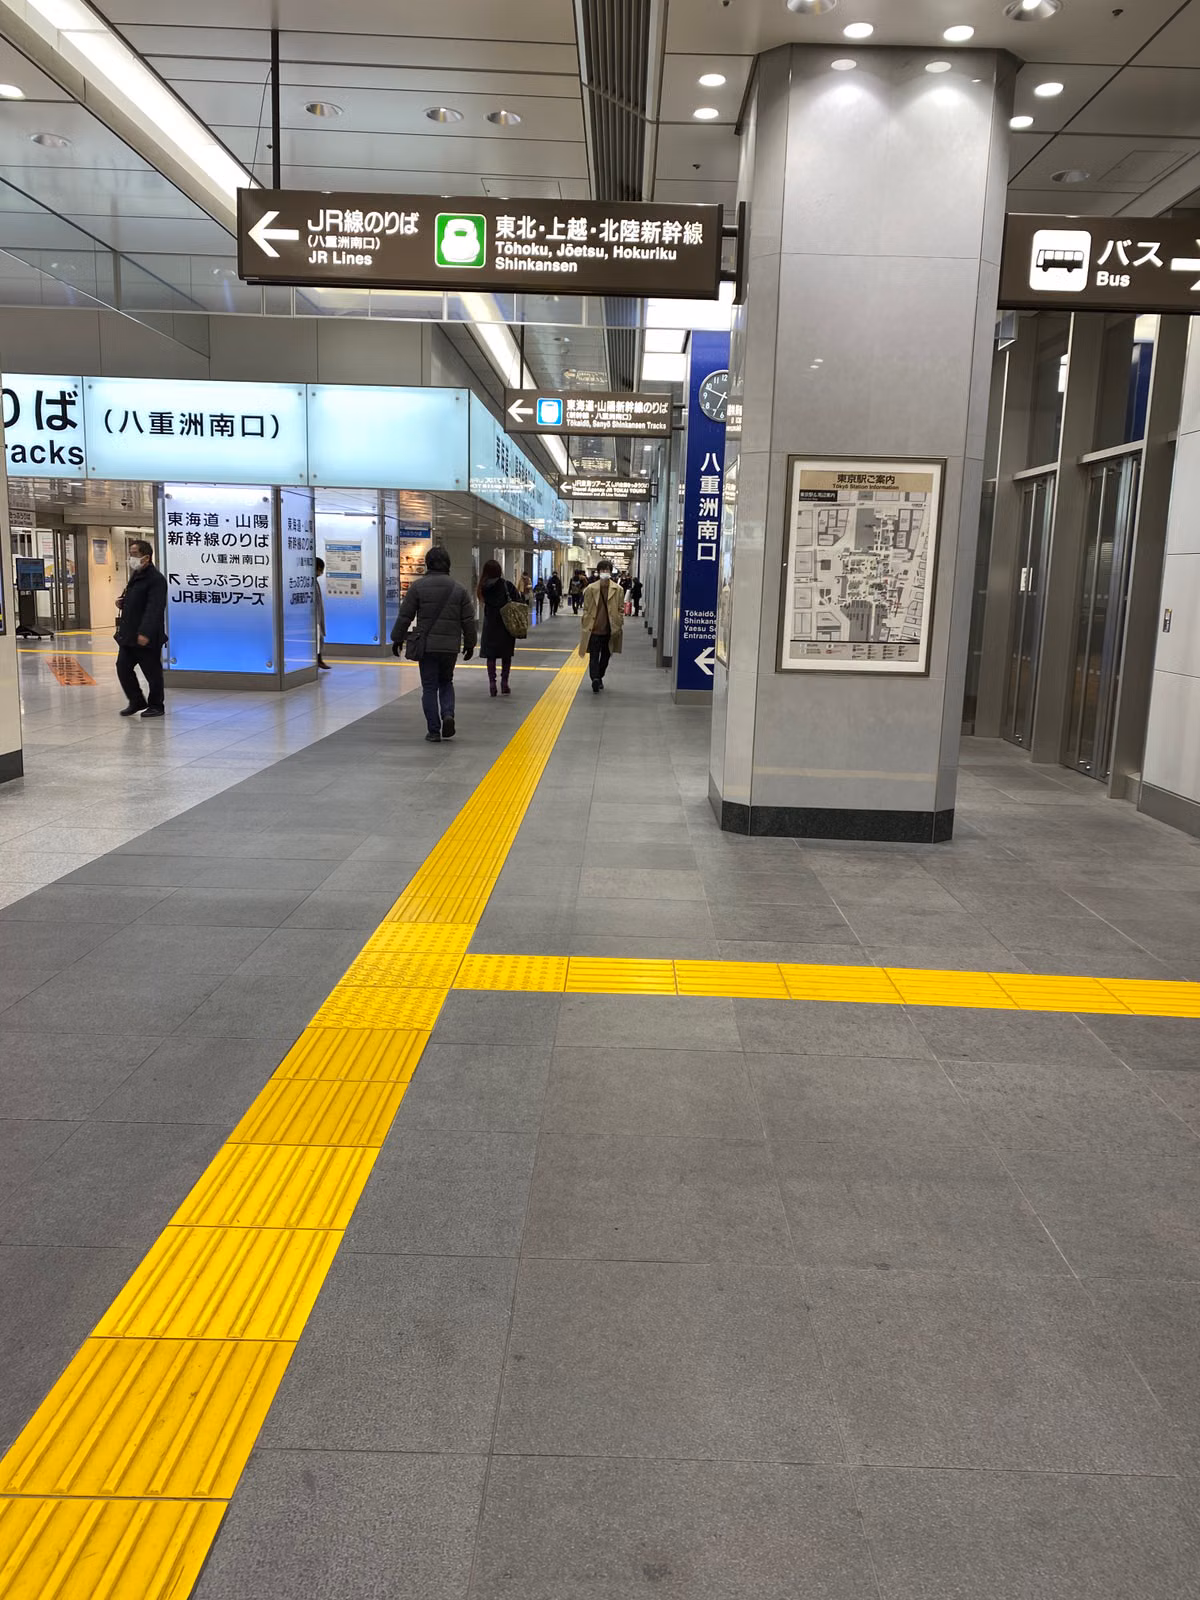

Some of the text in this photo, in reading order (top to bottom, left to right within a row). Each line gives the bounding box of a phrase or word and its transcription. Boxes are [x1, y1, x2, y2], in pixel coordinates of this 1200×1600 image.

[307, 208, 419, 236] JR線のりば
[495, 215, 704, 245] 東北・上越・北陸新幹線
[307, 235, 380, 251] (八重洲南口)
[308, 252, 373, 266] JR Lines
[613, 245, 677, 261] Hokuriku
[1096, 239, 1164, 268] バス
[496, 256, 578, 274] Shinkansen
[1096, 270, 1131, 288] Bus
[713, 376, 720, 384] 11
[721, 374, 728, 382] 12
[719, 411, 725, 419] 6
[104, 409, 280, 440] (八重洲南口)
[612, 421, 646, 430] Shinkansen
[647, 423, 667, 431] Tracks
[5, 440, 84, 465] acks
[837, 473, 896, 485] 東京駅ご案内
[696, 451, 721, 563] 八重洲南口
[167, 511, 270, 529] 東海道・山陽
[167, 531, 270, 548] 新幹線のりば
[200, 553, 270, 567] (八重洲南口)
[186, 574, 269, 590] きっぷうりば
[171, 591, 266, 607] JR東海ツアーズ
